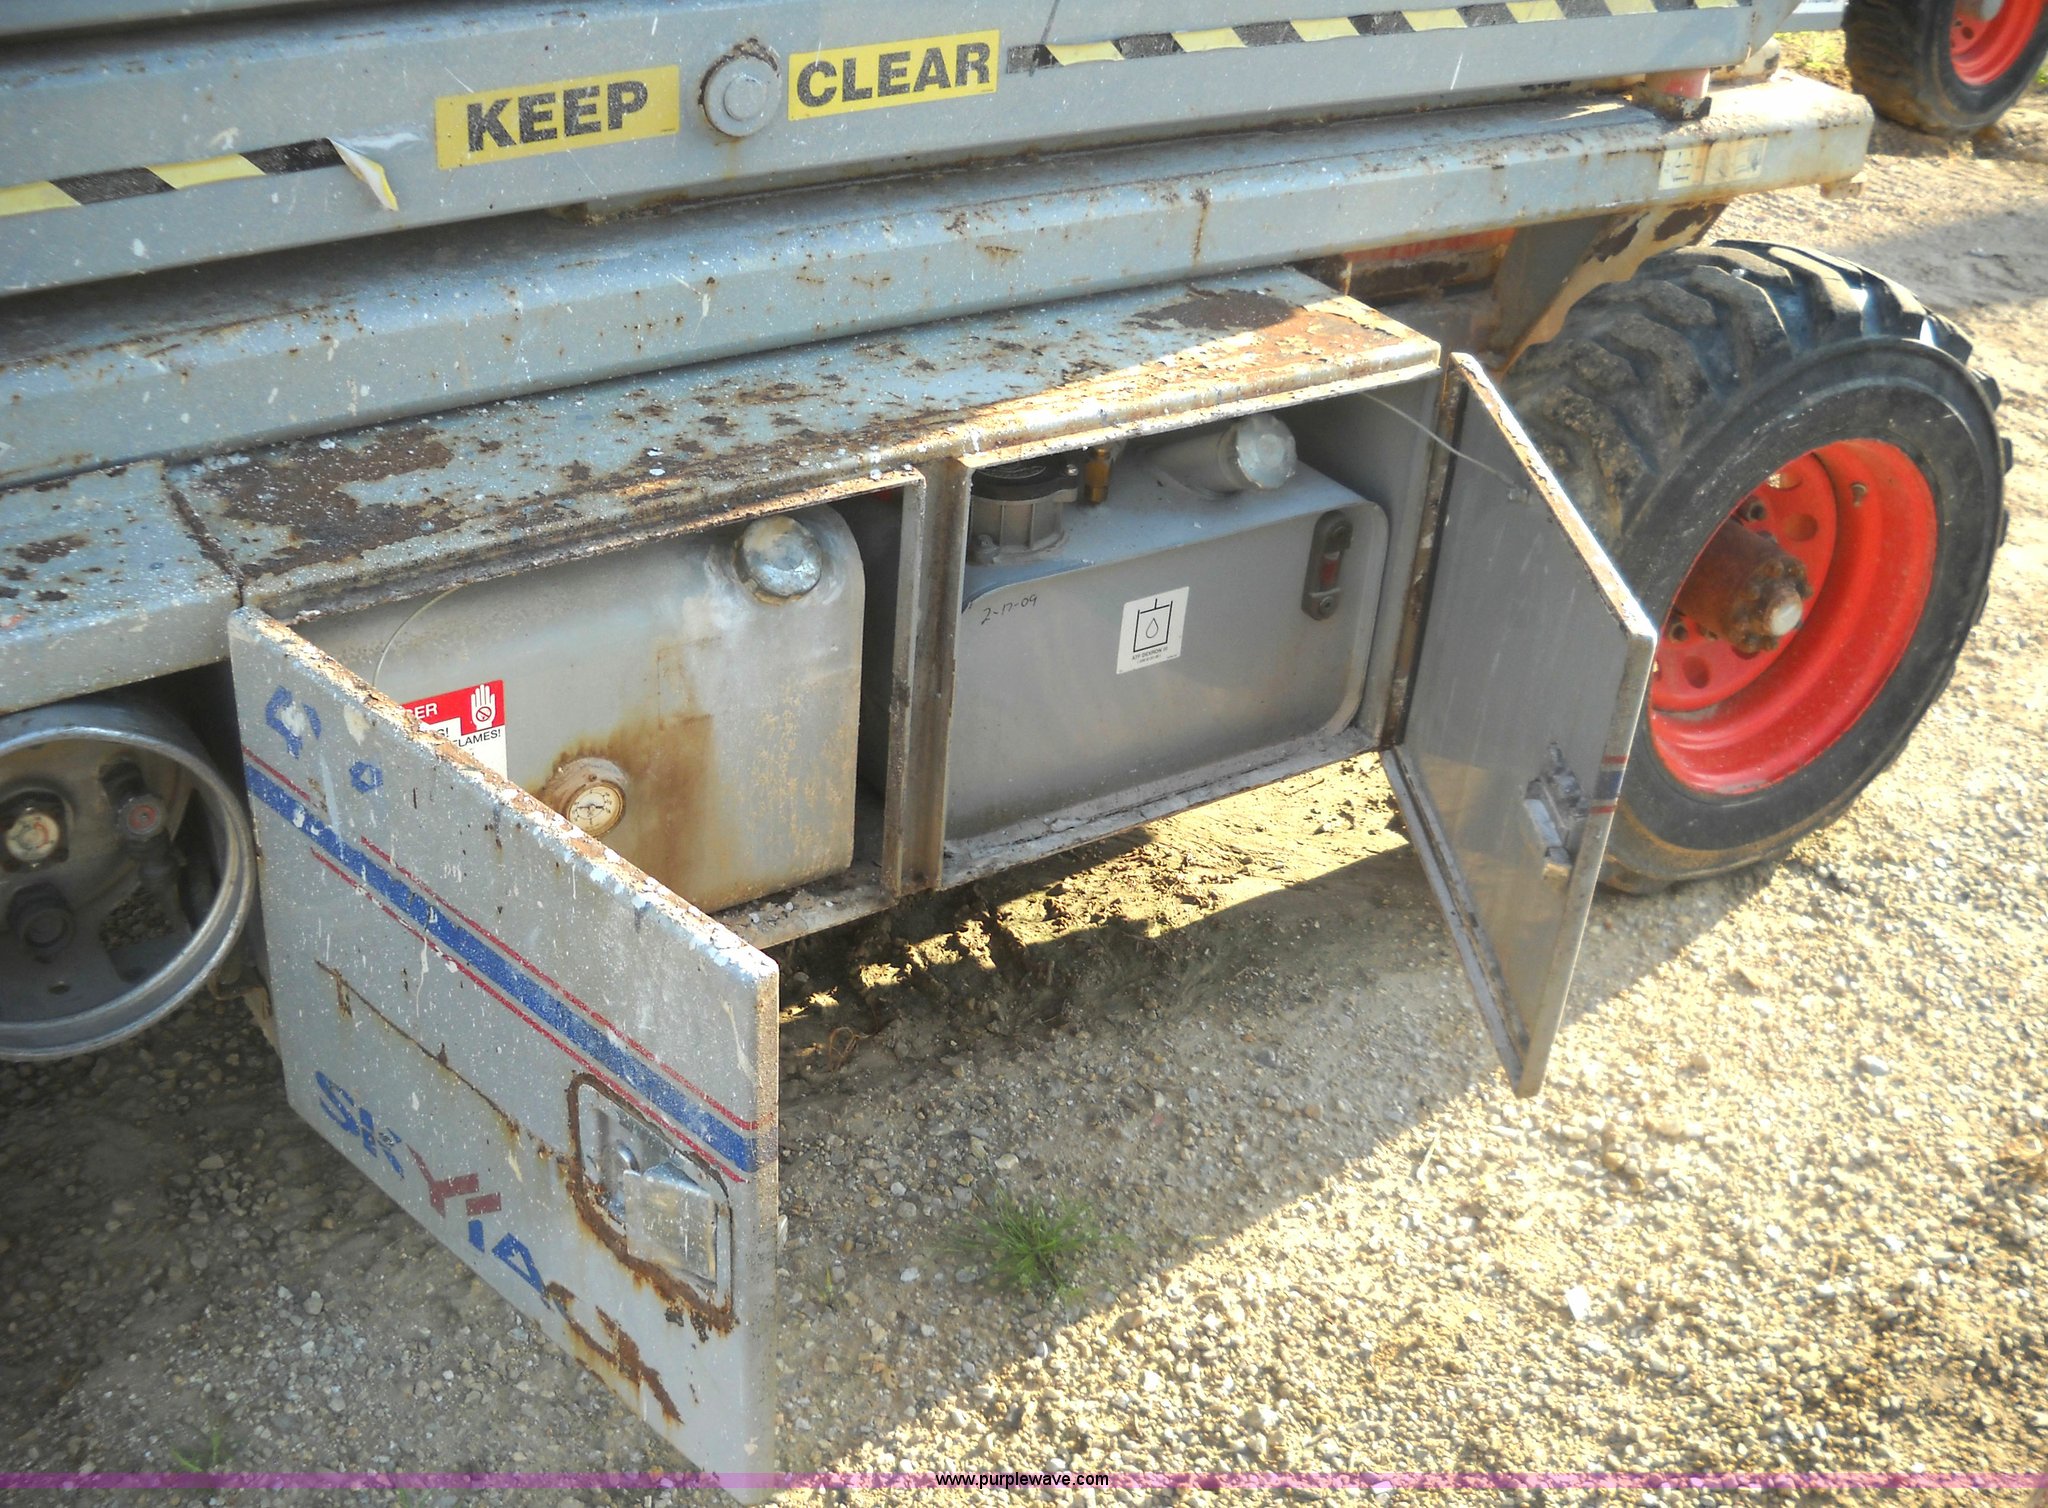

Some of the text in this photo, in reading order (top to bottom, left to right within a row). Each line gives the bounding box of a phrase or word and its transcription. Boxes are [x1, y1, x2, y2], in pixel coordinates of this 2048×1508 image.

[467, 42, 991, 152] KEEP CLEAR
[453, 729, 501, 747] LAMES!
